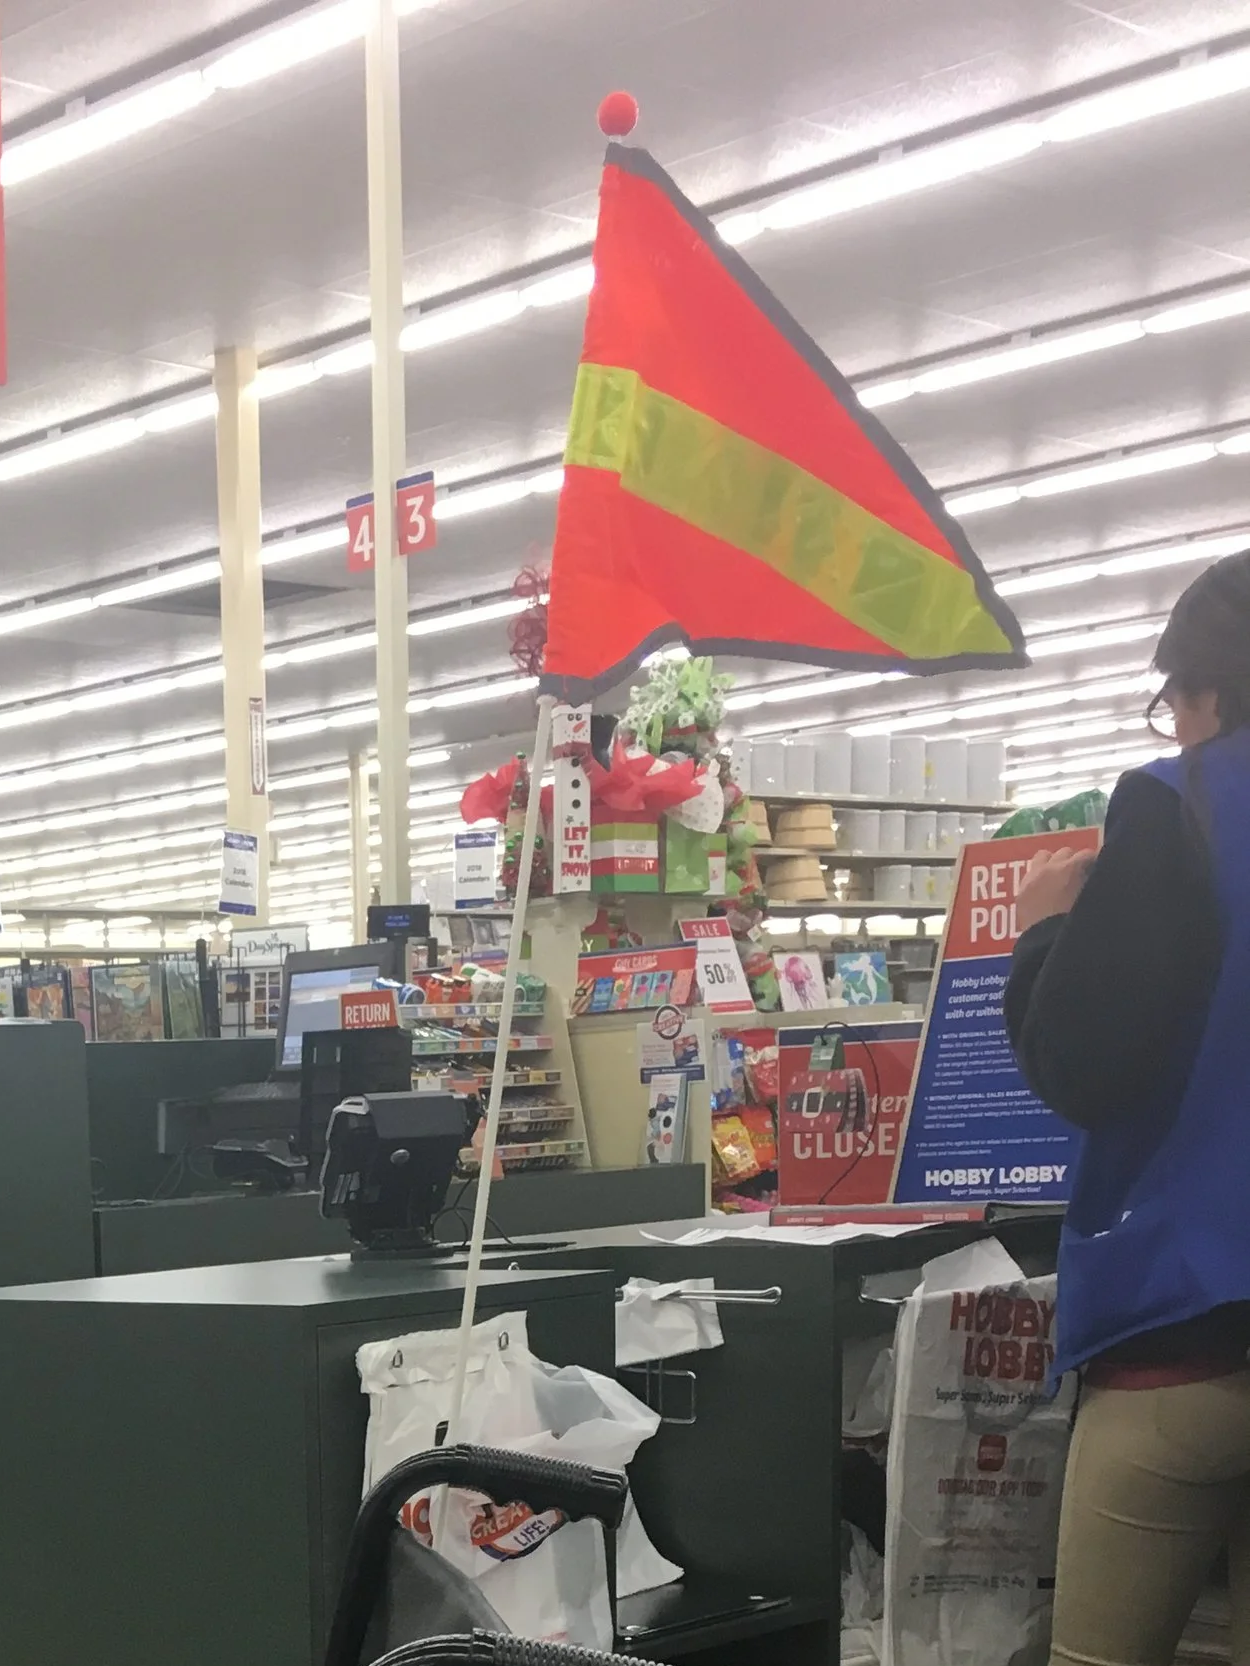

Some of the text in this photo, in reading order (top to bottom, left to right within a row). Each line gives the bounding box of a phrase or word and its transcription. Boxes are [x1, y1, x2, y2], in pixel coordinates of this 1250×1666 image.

[406, 495, 426, 544] 3
[353, 515, 374, 562] 4
[564, 826, 588, 840] LET
[568, 844, 584, 858] IT
[561, 862, 590, 877] SNOW
[971, 859, 1031, 901] RET
[692, 923, 720, 937] SALE
[951, 974, 1006, 989] Hobby Lobby
[948, 991, 989, 1005] customer
[345, 1003, 391, 1025] RETURN
[945, 1008, 965, 1019] with
[965, 1009, 976, 1018] or
[925, 1165, 1068, 1187] HOBBY LOBBY
[950, 1292, 1056, 1338] HOBBY
[513, 1519, 550, 1547] LIFE!
